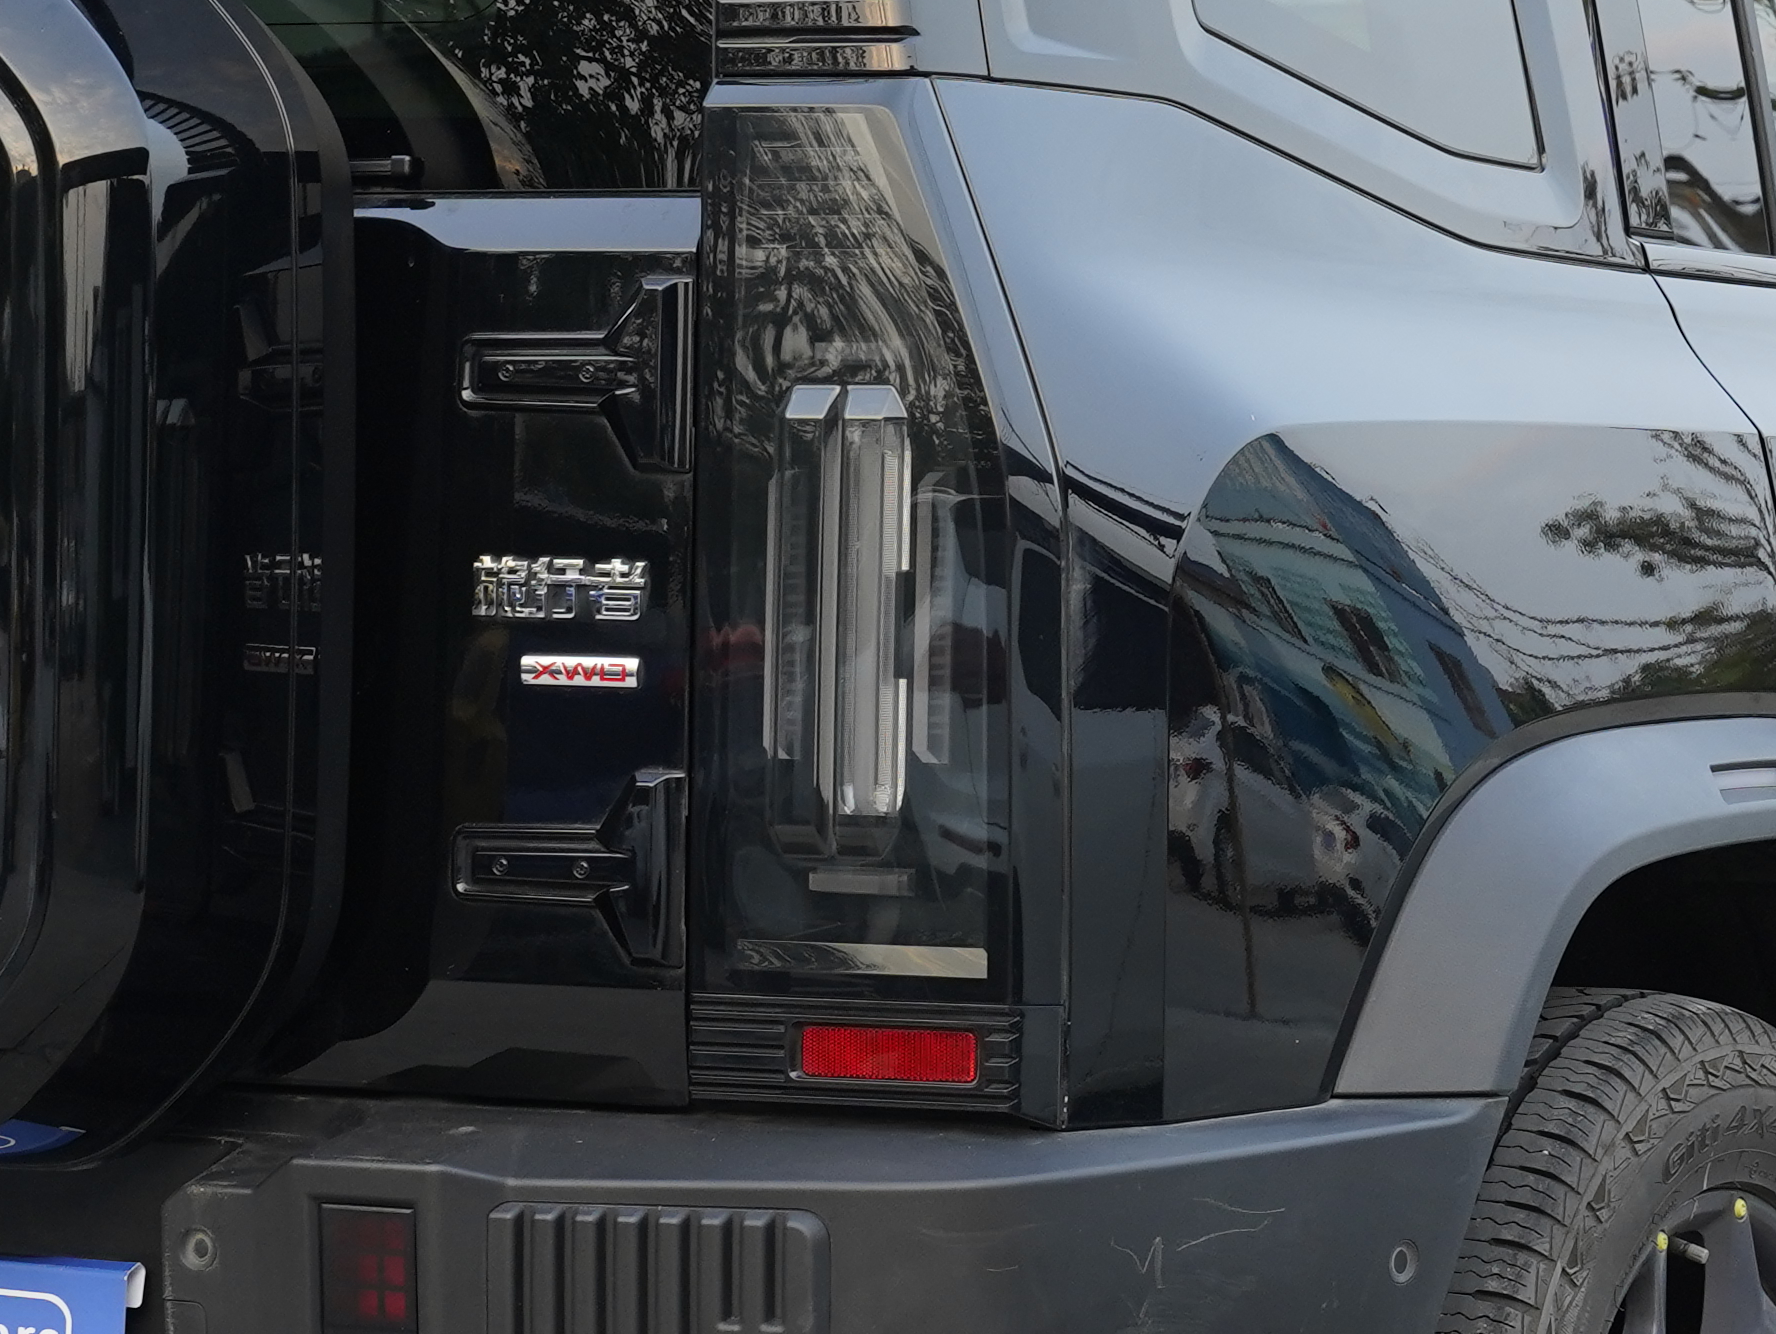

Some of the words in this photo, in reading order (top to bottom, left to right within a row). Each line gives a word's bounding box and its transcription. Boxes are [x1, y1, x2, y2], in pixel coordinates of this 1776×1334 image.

[473, 556, 648, 621] 旅行者
[531, 661, 627, 683] XWD
